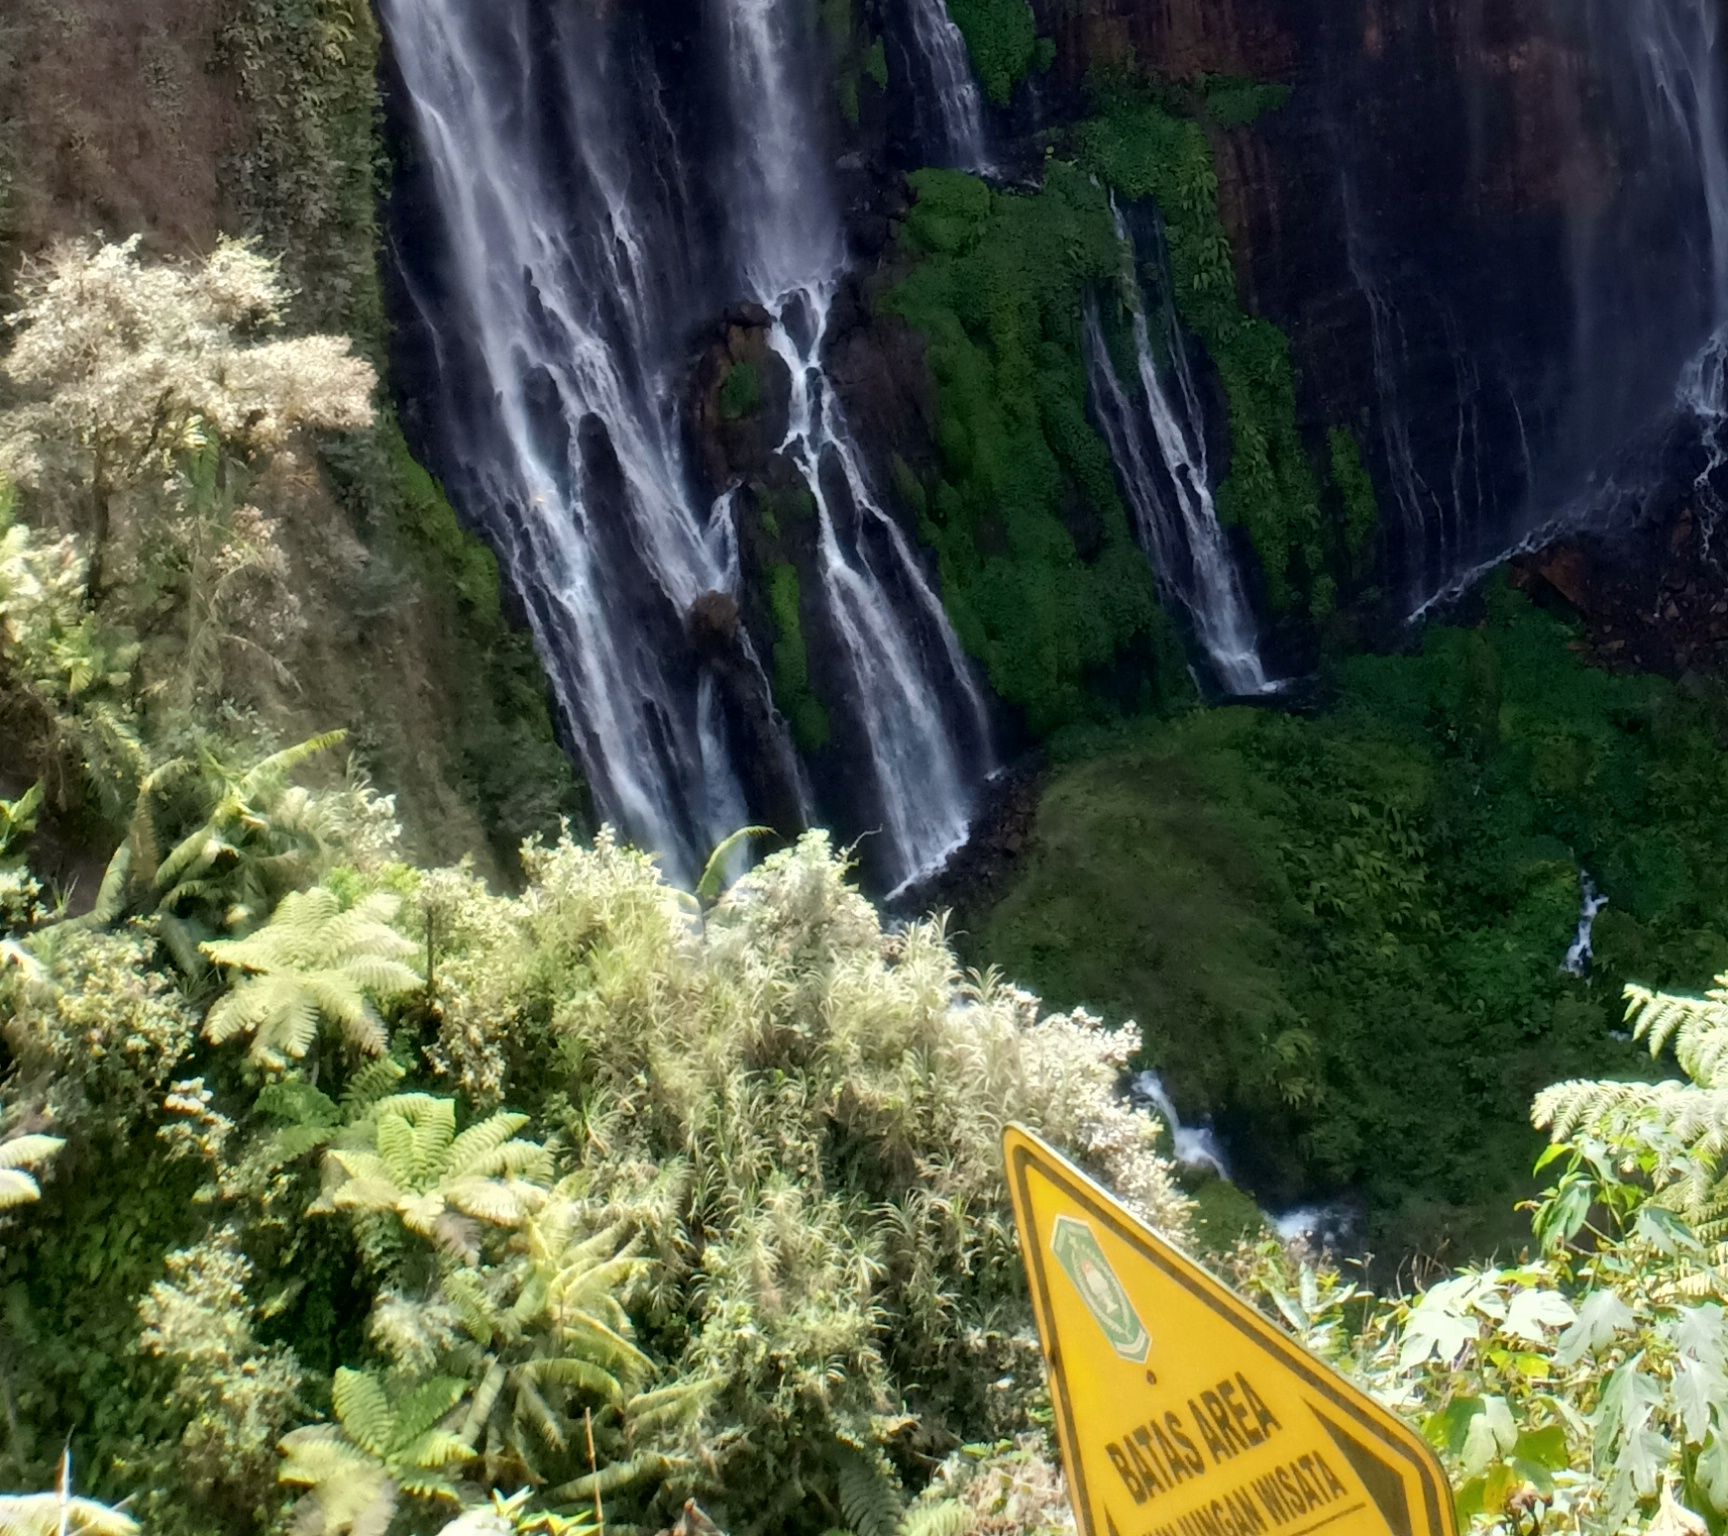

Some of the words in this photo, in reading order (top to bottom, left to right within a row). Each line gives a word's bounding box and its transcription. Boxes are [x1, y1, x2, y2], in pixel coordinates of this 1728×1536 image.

[1105, 1410, 1205, 1504] BATAS
[1187, 1371, 1283, 1465] AREA
[1250, 1450, 1348, 1527] WISATA
